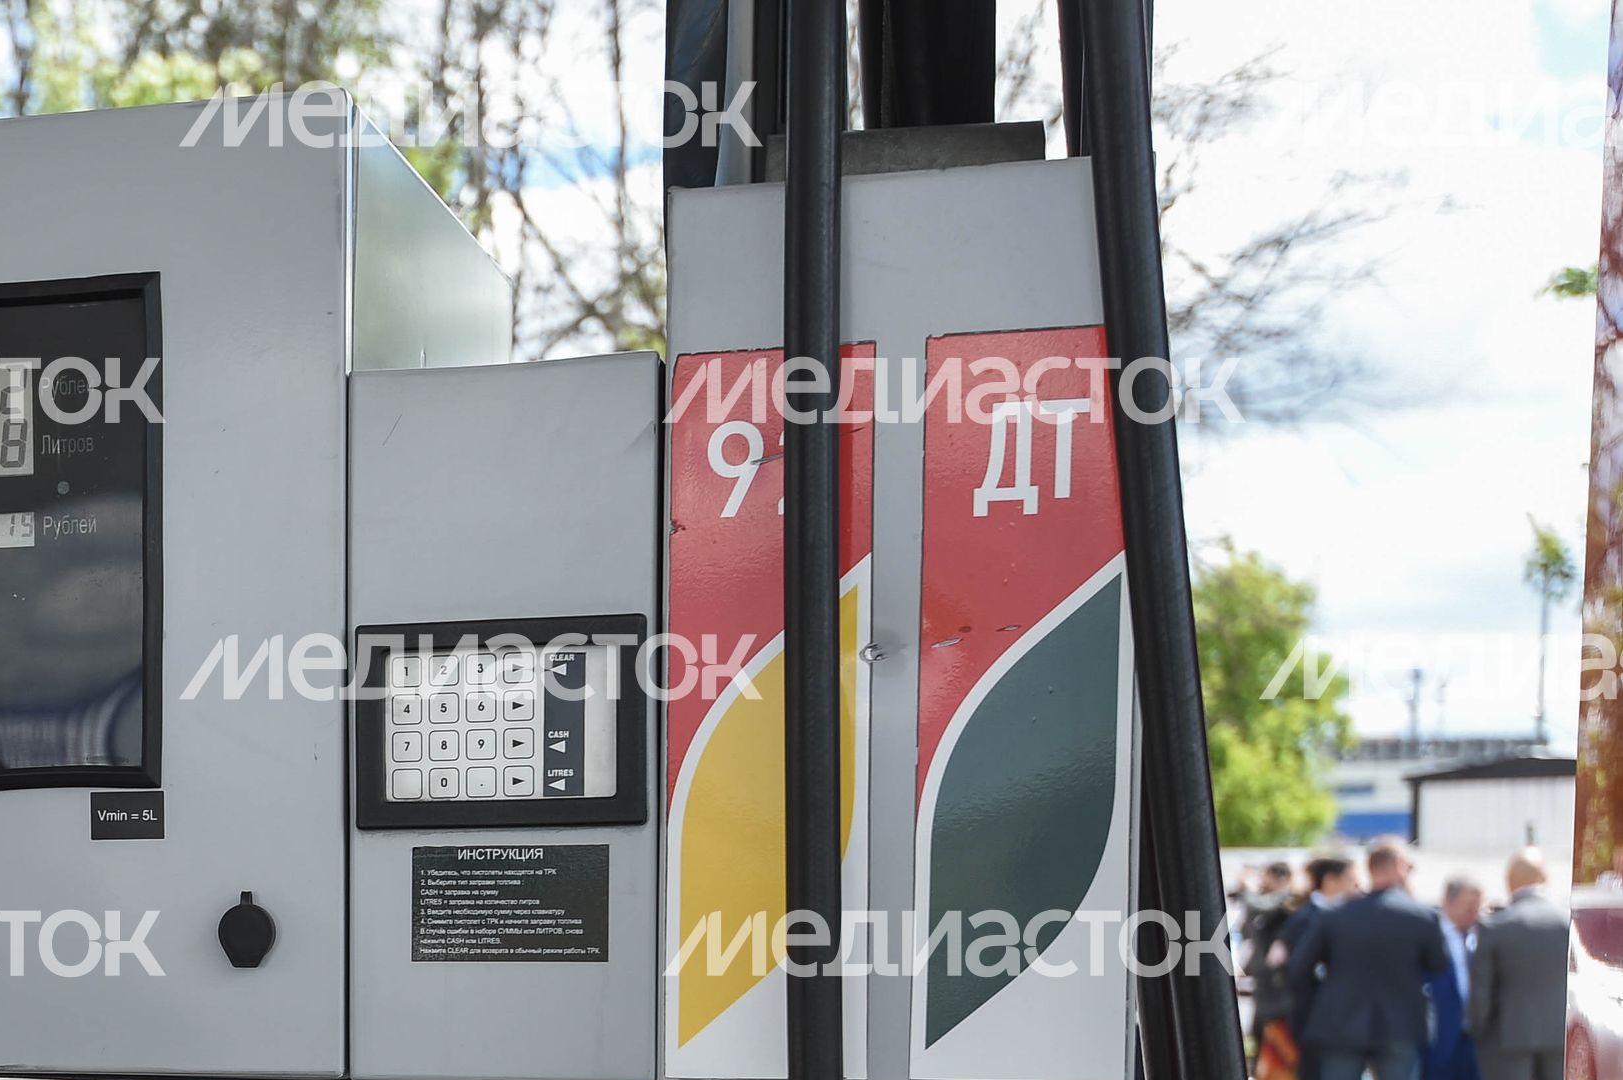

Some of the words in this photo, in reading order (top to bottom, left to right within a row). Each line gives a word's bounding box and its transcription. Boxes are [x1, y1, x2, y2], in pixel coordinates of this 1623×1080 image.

[41, 435, 94, 455] Литров
[973, 398, 1091, 517] ДТ
[707, 420, 785, 518] 9
[43, 516, 97, 540] Рублей
[549, 654, 575, 662] CLEAR
[404, 666, 409, 677] 1
[440, 665, 447, 675] 2
[477, 663, 484, 673] 3
[403, 704, 410, 714] 4
[440, 703, 447, 713] 5
[477, 701, 485, 711] 6
[548, 730, 569, 738] CASH
[404, 741, 410, 751] 7
[440, 740, 447, 750] 8
[477, 739, 485, 749] 9
[547, 769, 574, 777] LITRES
[440, 777, 448, 787] 0
[98, 809, 127, 821] Vmin
[142, 809, 158, 821] 5L
[457, 848, 544, 862] ИНСТРУКЦИЯ
